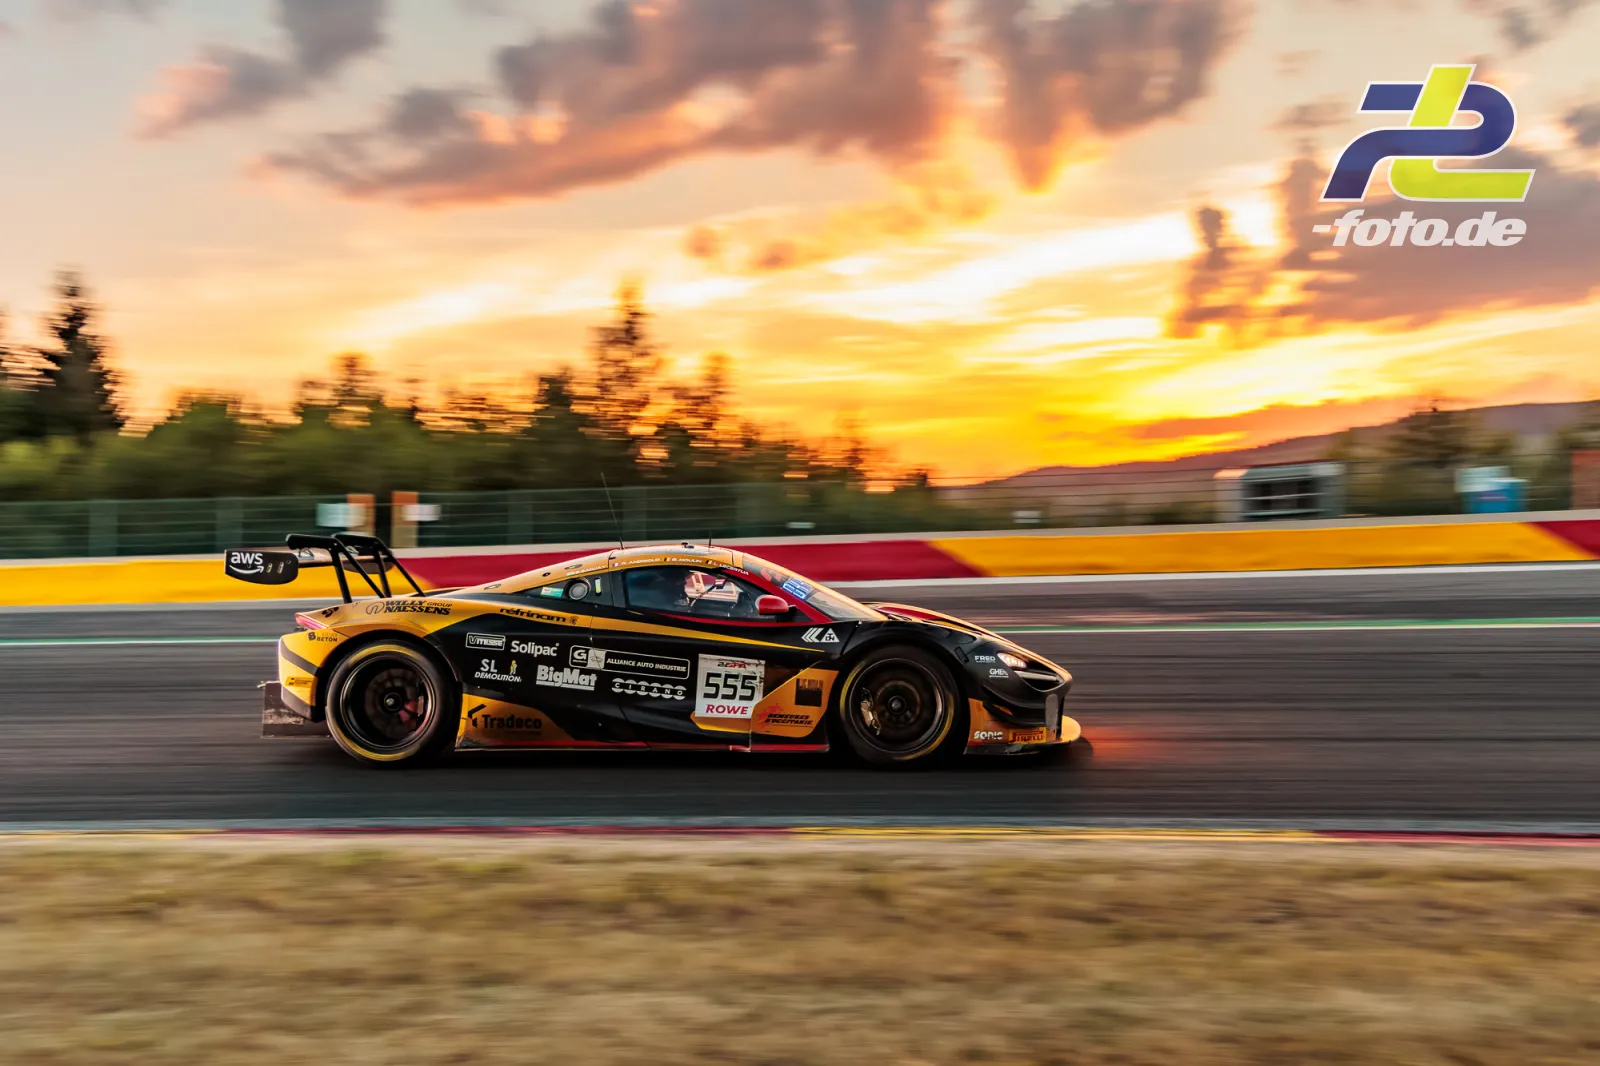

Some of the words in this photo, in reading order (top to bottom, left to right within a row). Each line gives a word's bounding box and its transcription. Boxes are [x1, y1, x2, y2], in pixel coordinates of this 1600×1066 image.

[230, 551, 264, 565] aws
[385, 599, 427, 607] WILLY
[383, 605, 452, 616] NAESSENS
[510, 640, 558, 657] Solipac
[480, 658, 498, 673] SL
[606, 658, 636, 667] ALLIANCE
[636, 661, 655, 669] AUTO
[654, 663, 687, 672] INDUSTRIE
[474, 671, 521, 683] DEMOLITION
[536, 664, 598, 687] BigMat
[614, 682, 683, 696] CIRANO
[702, 671, 758, 702] 555
[705, 703, 749, 715] ROWE
[481, 713, 543, 729] Tradeco
